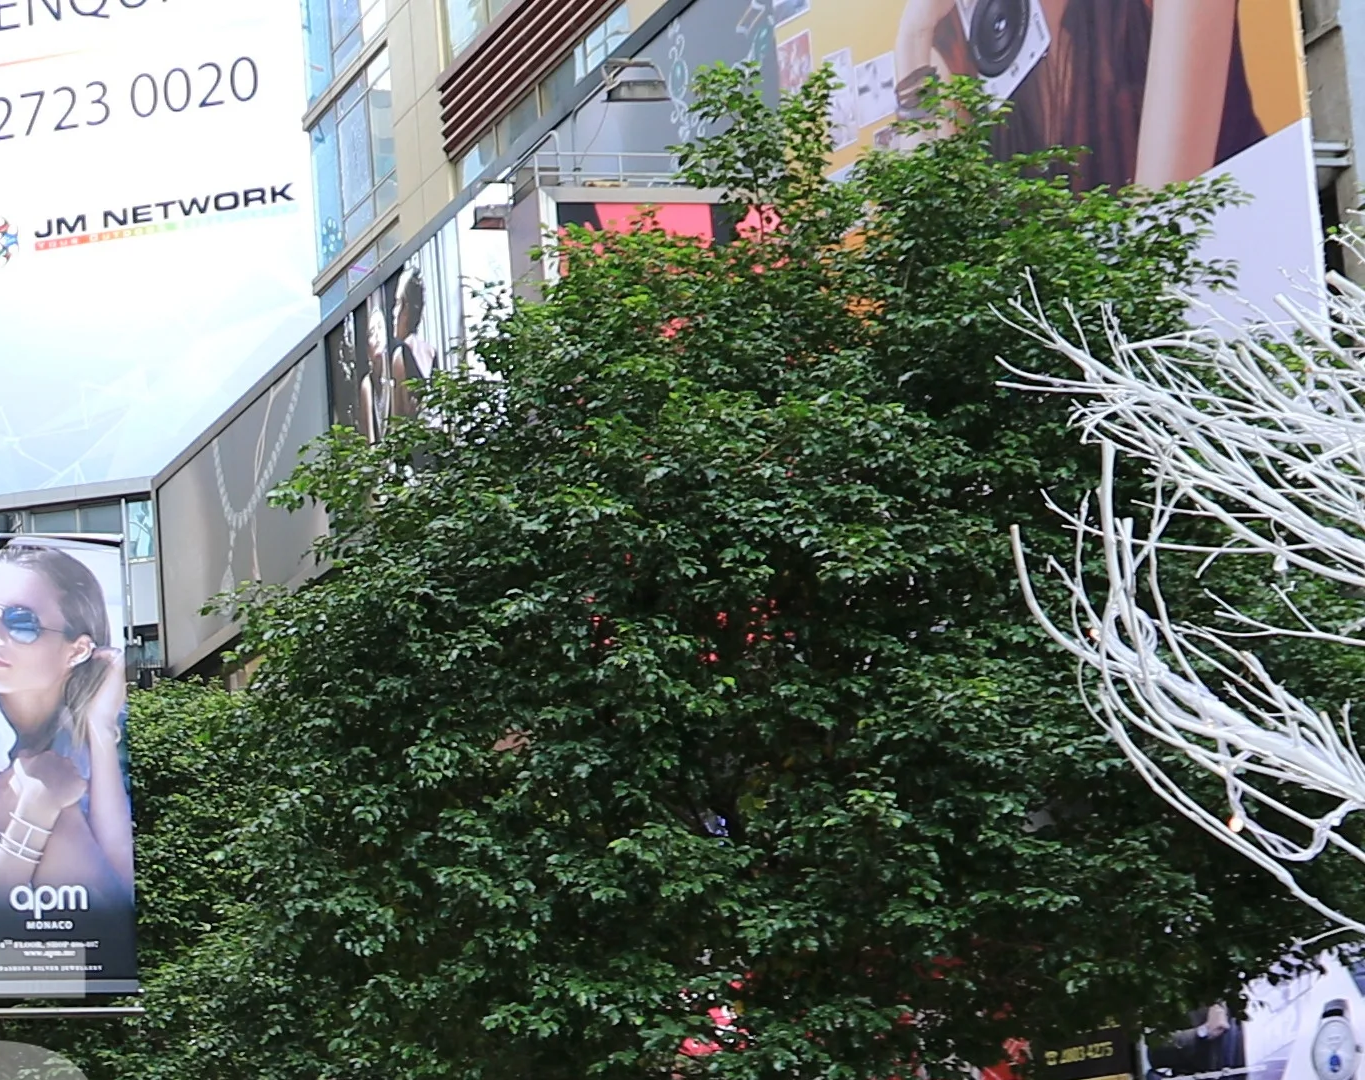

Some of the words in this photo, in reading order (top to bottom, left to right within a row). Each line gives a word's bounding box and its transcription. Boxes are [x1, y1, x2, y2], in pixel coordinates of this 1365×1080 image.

[130, 57, 259, 117] 0020
[34, 213, 87, 238] JM
[103, 181, 296, 229] NETWORK
[9, 885, 88, 920] apm
[26, 920, 73, 930] MONACO
